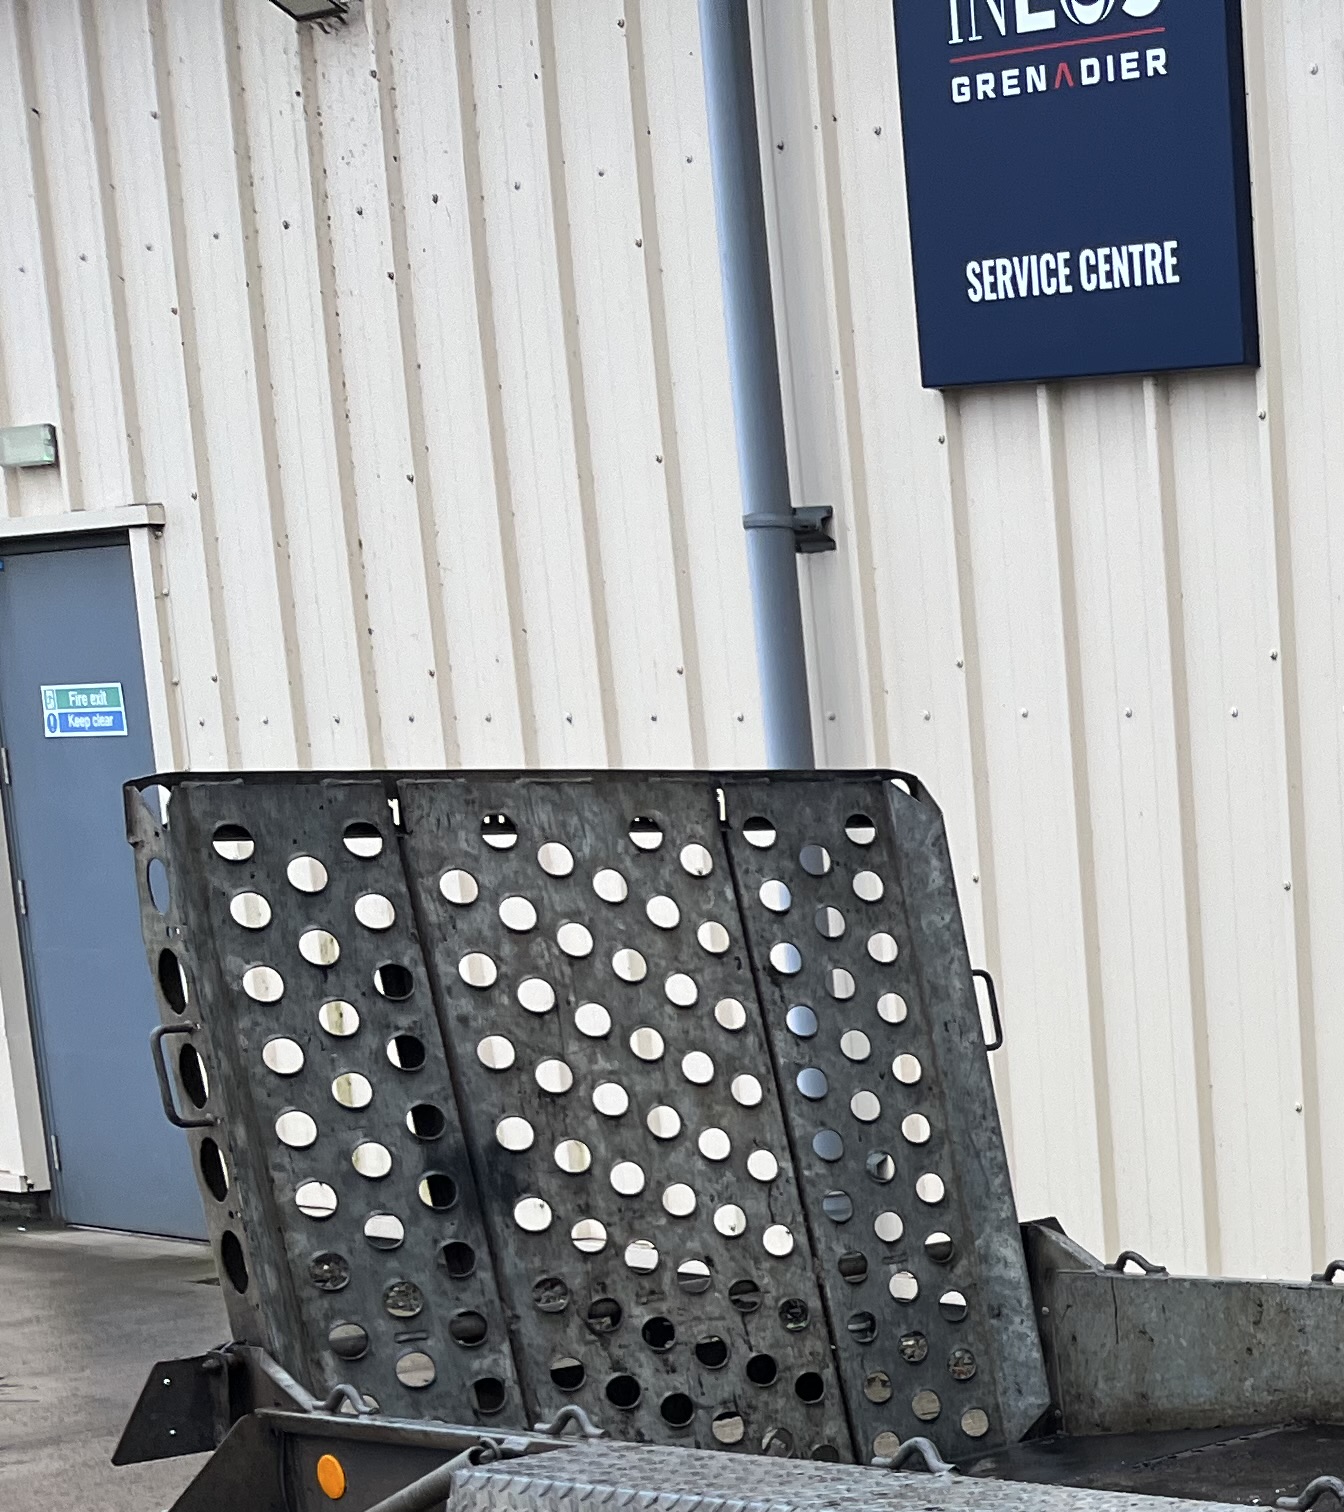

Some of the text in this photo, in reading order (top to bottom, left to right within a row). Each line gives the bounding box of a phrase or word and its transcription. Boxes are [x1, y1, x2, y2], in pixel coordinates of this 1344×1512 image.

[948, 0, 1161, 45] INE
[951, 47, 1168, 104] GRENADIER
[966, 240, 1180, 303] SERVICE CENTRE
[68, 690, 108, 707] Fire exit
[68, 713, 114, 730] Keep clear
